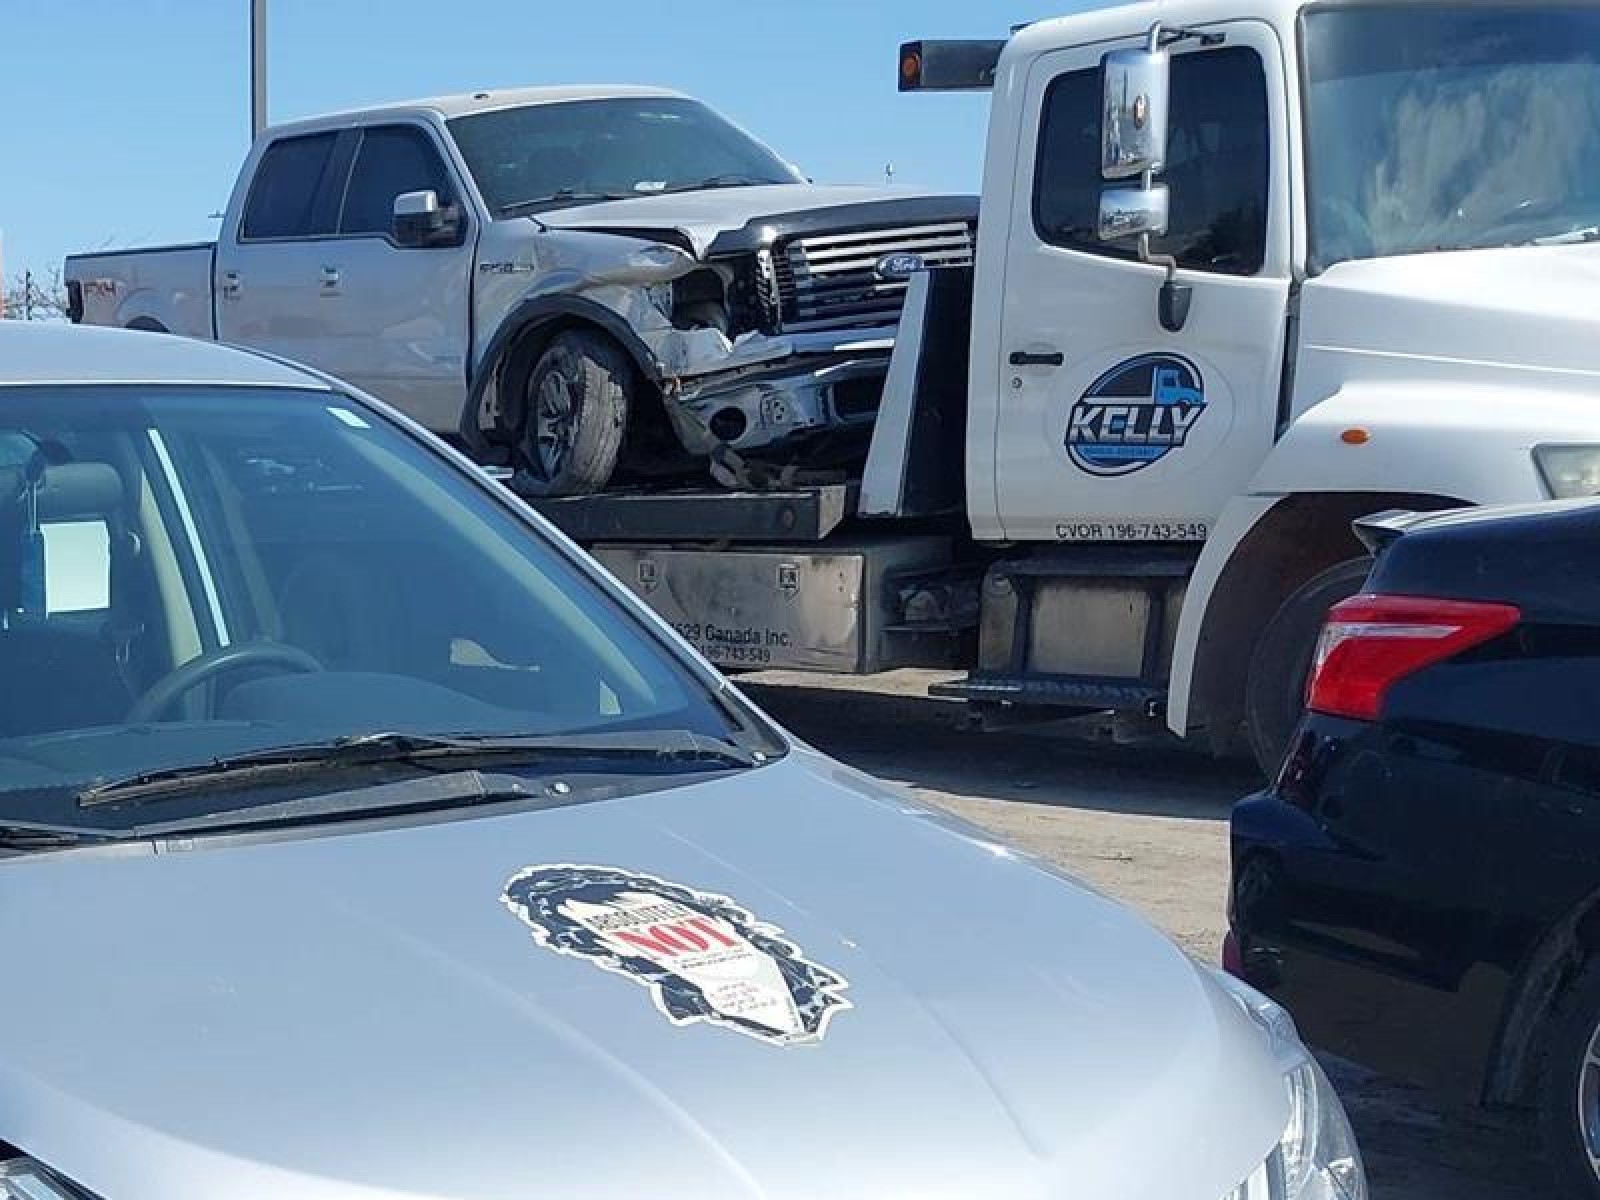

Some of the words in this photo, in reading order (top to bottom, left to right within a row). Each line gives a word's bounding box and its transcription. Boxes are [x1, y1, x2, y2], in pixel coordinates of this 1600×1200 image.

[1068, 405, 1203, 443] KELLY
[1056, 523, 1103, 539] CVOR
[1108, 523, 1207, 539] 196-743-549
[705, 623, 761, 645] Canada
